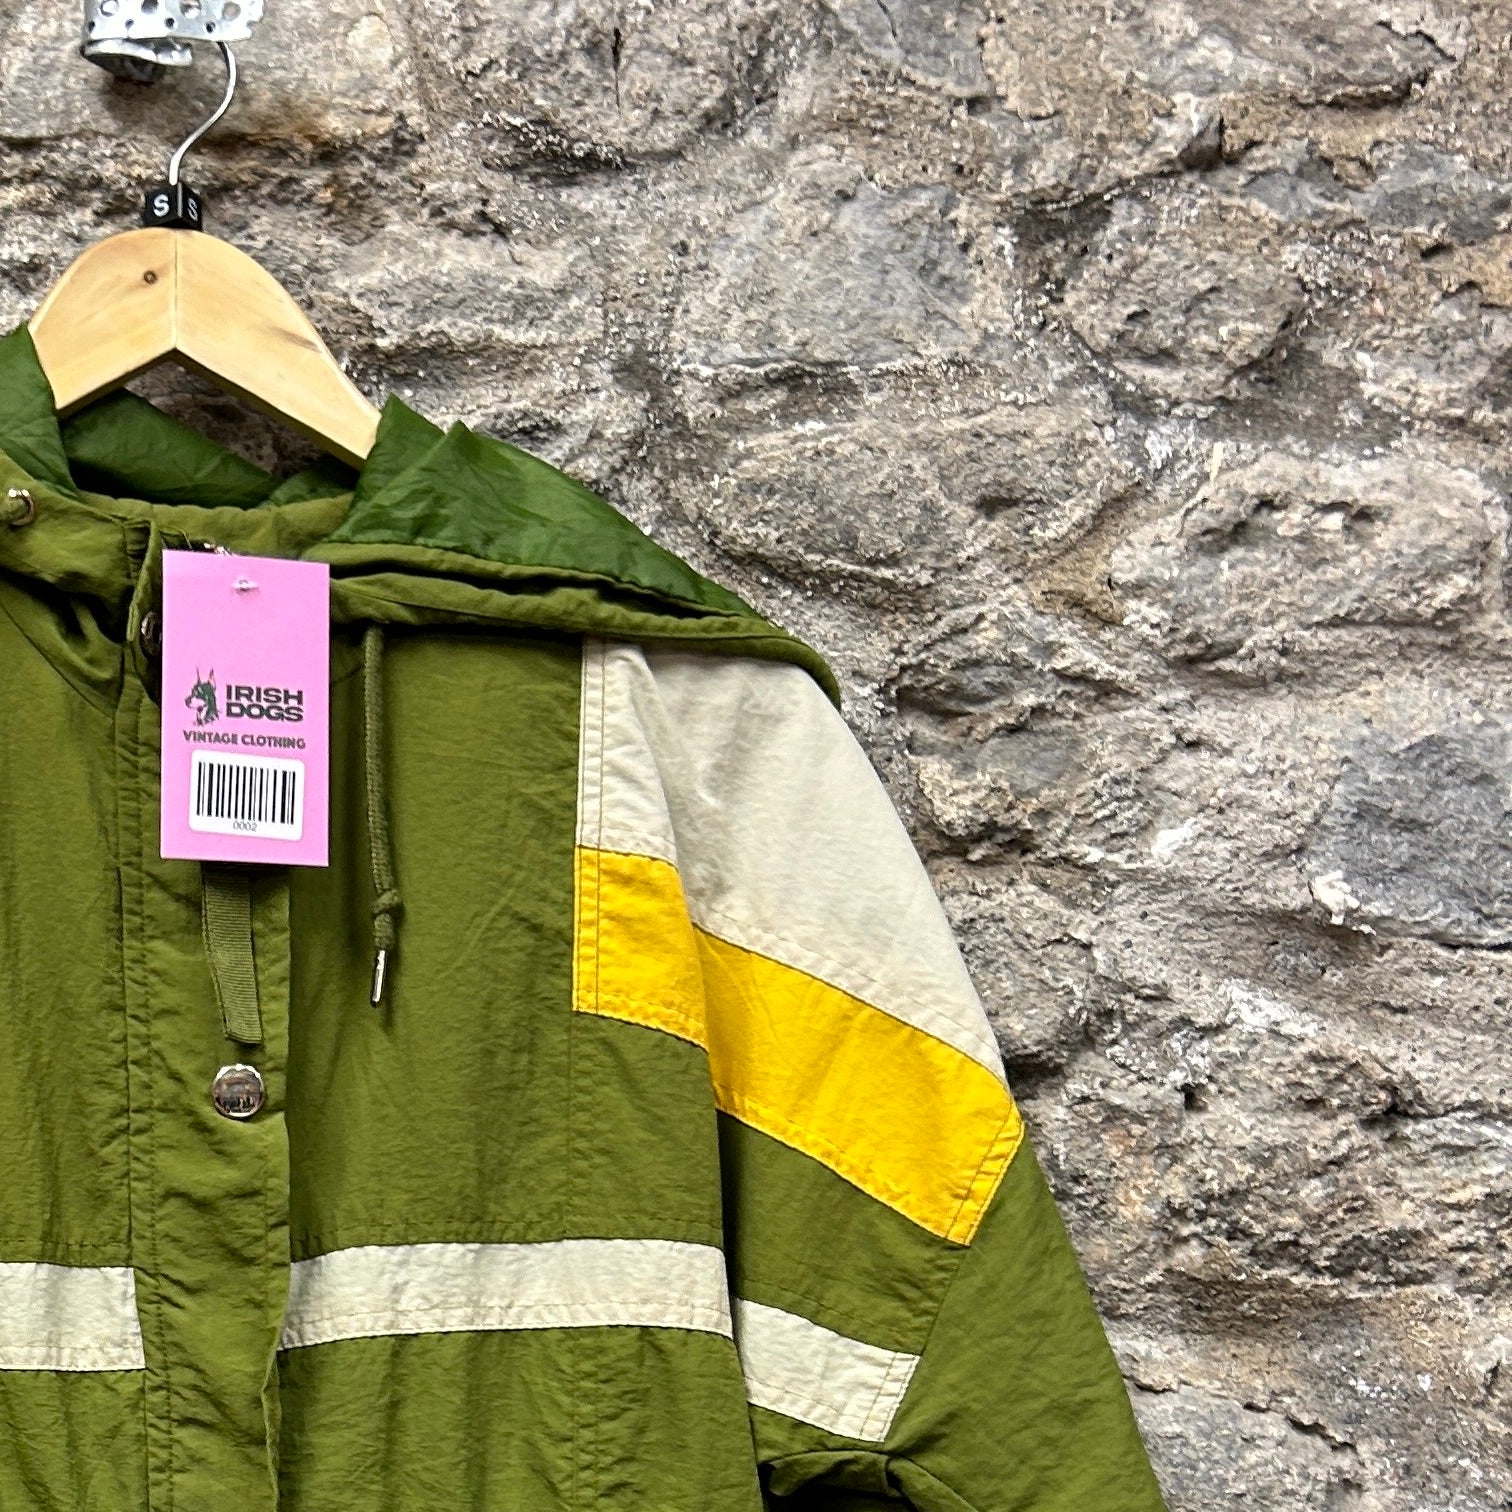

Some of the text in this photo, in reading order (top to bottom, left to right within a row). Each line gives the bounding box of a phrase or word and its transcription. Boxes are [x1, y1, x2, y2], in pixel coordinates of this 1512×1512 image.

[153, 194, 170, 217] S
[188, 198, 198, 221] S
[226, 684, 303, 705] IRISH
[226, 701, 304, 722] DOGS
[183, 730, 306, 749] VINTAGE CLOTHING
[233, 821, 257, 832] 0002
